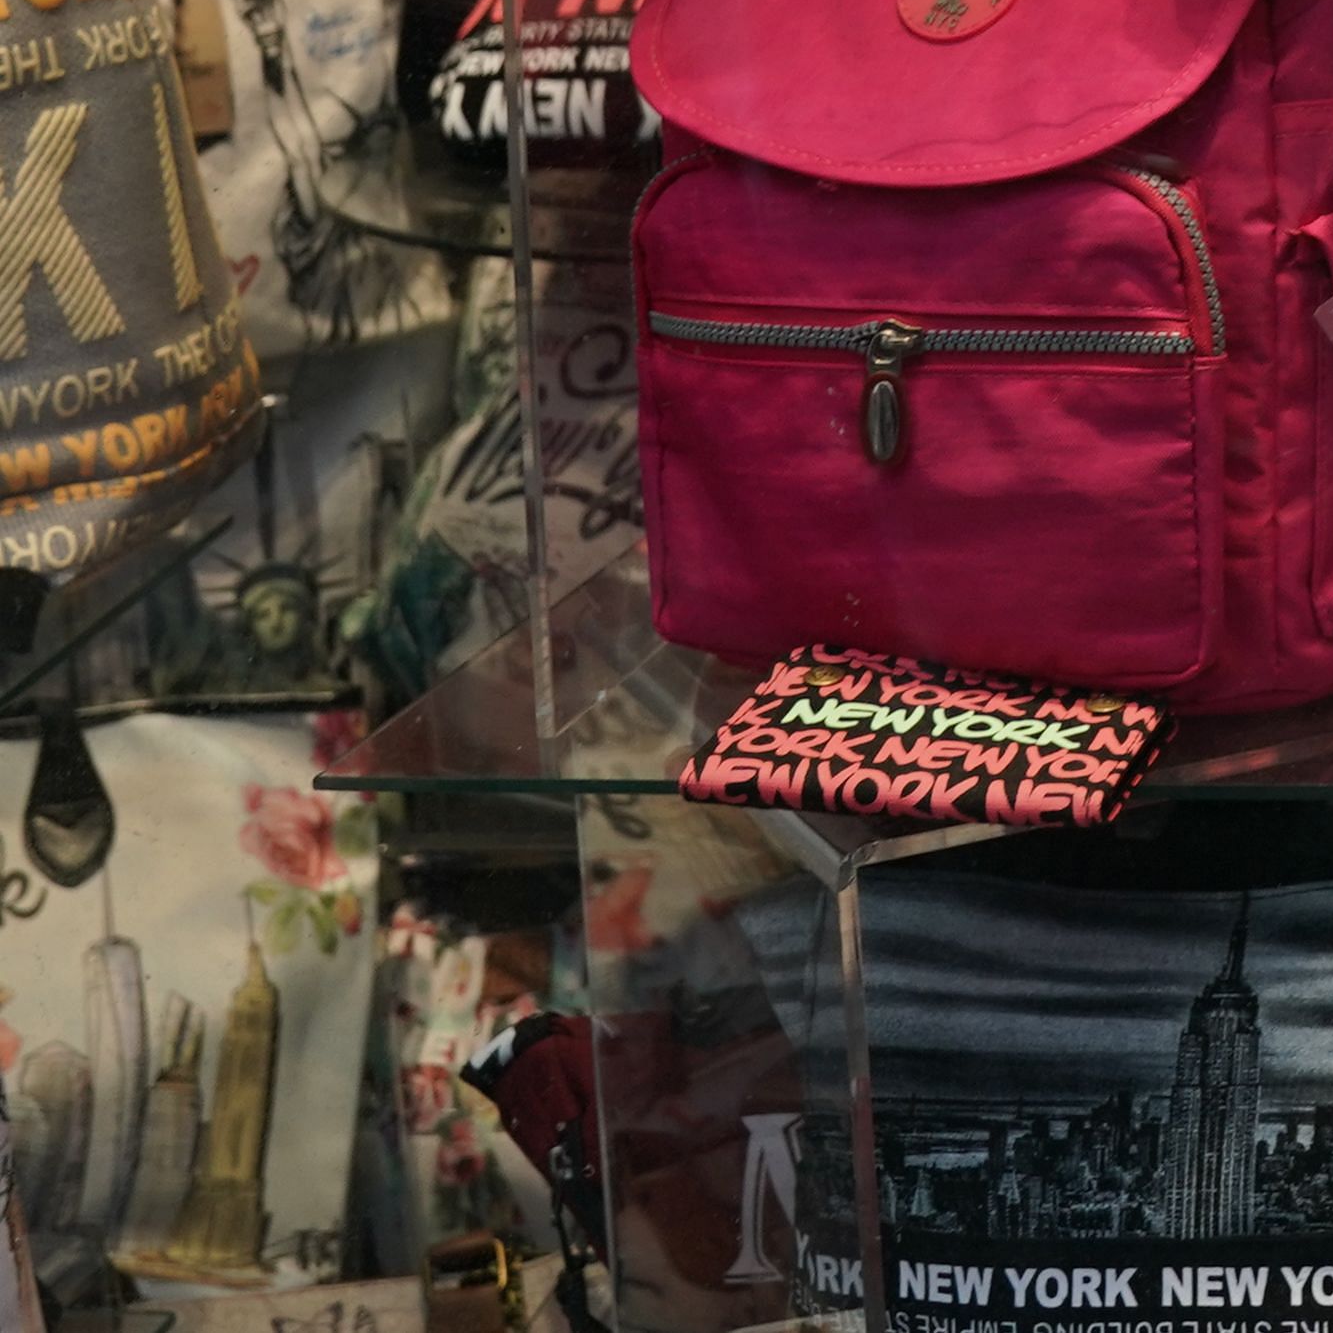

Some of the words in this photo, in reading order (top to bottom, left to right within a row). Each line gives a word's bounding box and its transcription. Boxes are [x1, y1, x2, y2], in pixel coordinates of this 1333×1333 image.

[880, 675, 1028, 718] YORK
[714, 724, 879, 764] YORK
[873, 734, 1020, 772] NEW
[781, 697, 927, 737] NEW
[930, 706, 1094, 752] YORK
[818, 759, 980, 823] YORK
[899, 1259, 995, 1308] NEW
[1004, 1266, 1139, 1308] YORK
[1160, 1266, 1269, 1309] NEW
